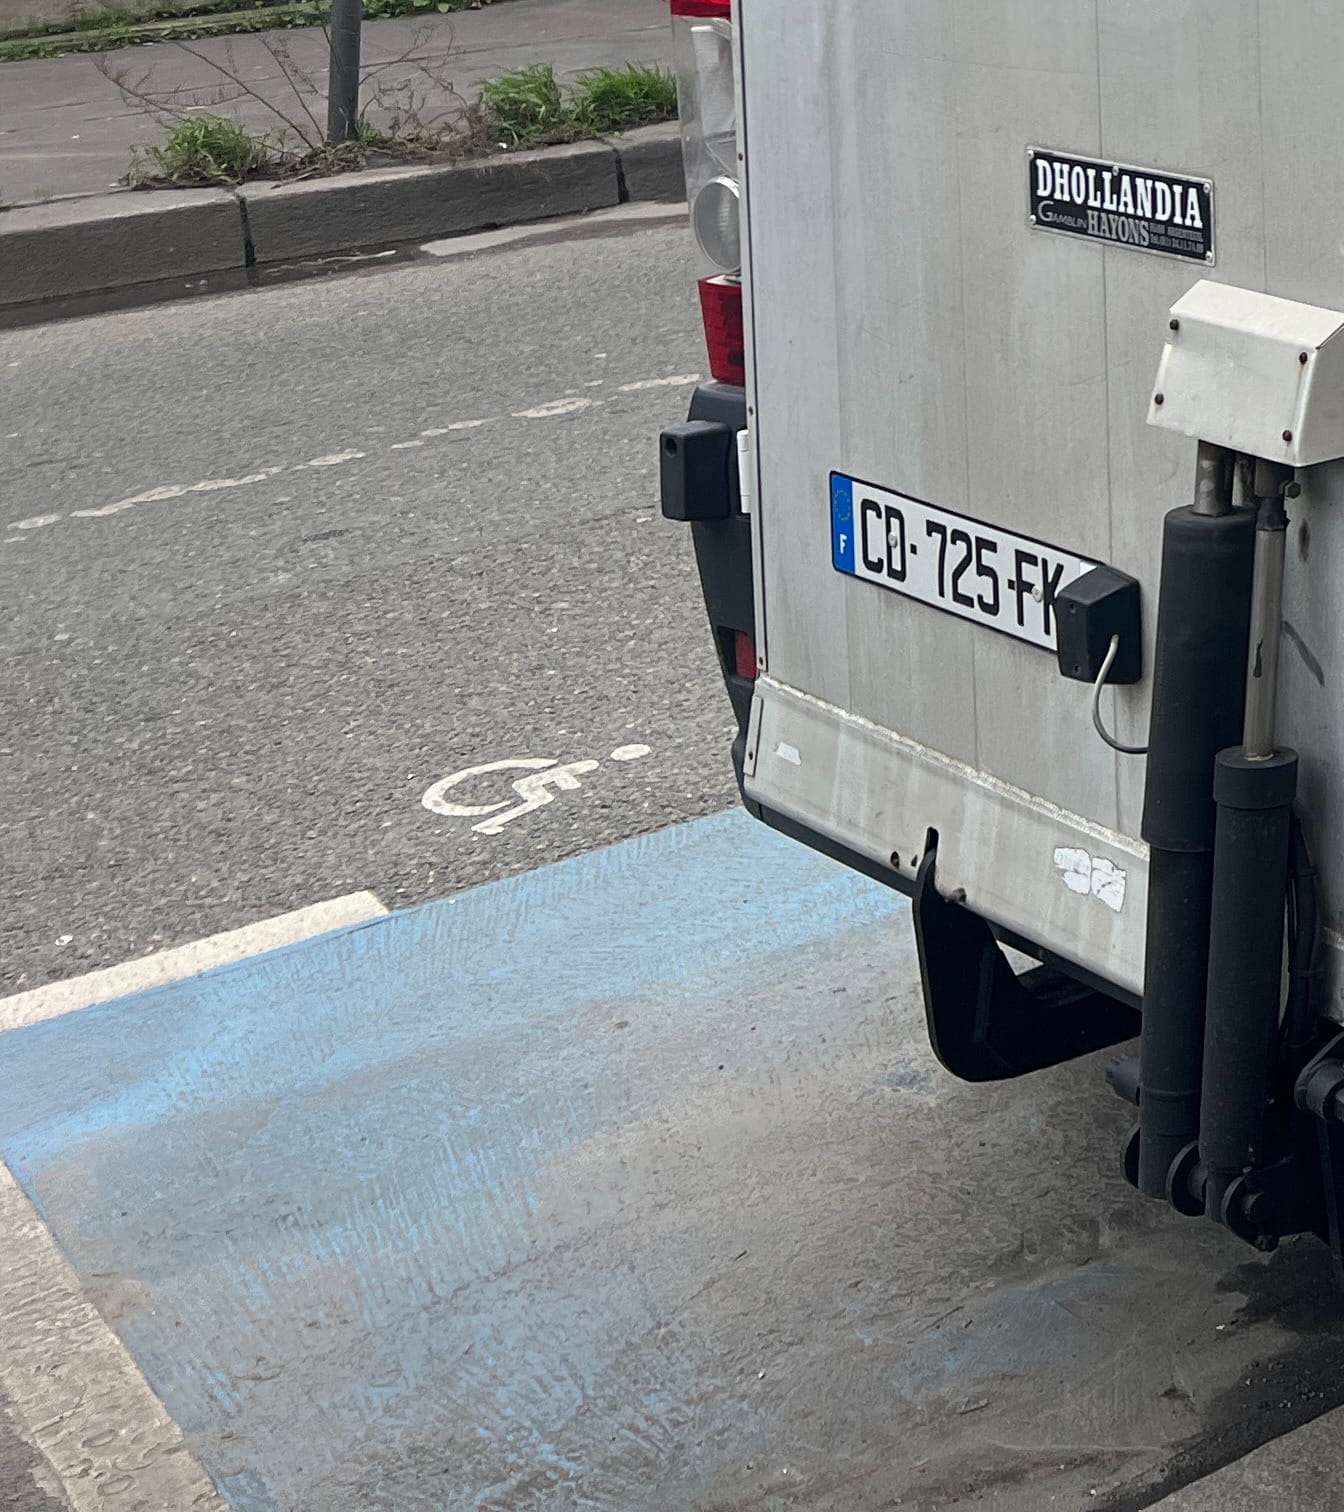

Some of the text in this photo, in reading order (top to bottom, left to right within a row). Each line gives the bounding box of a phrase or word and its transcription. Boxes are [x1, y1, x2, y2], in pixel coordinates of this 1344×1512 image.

[1035, 159, 1204, 229] DHOLLANDIA
[1086, 209, 1150, 247] HAYONS
[839, 533, 848, 555] F
